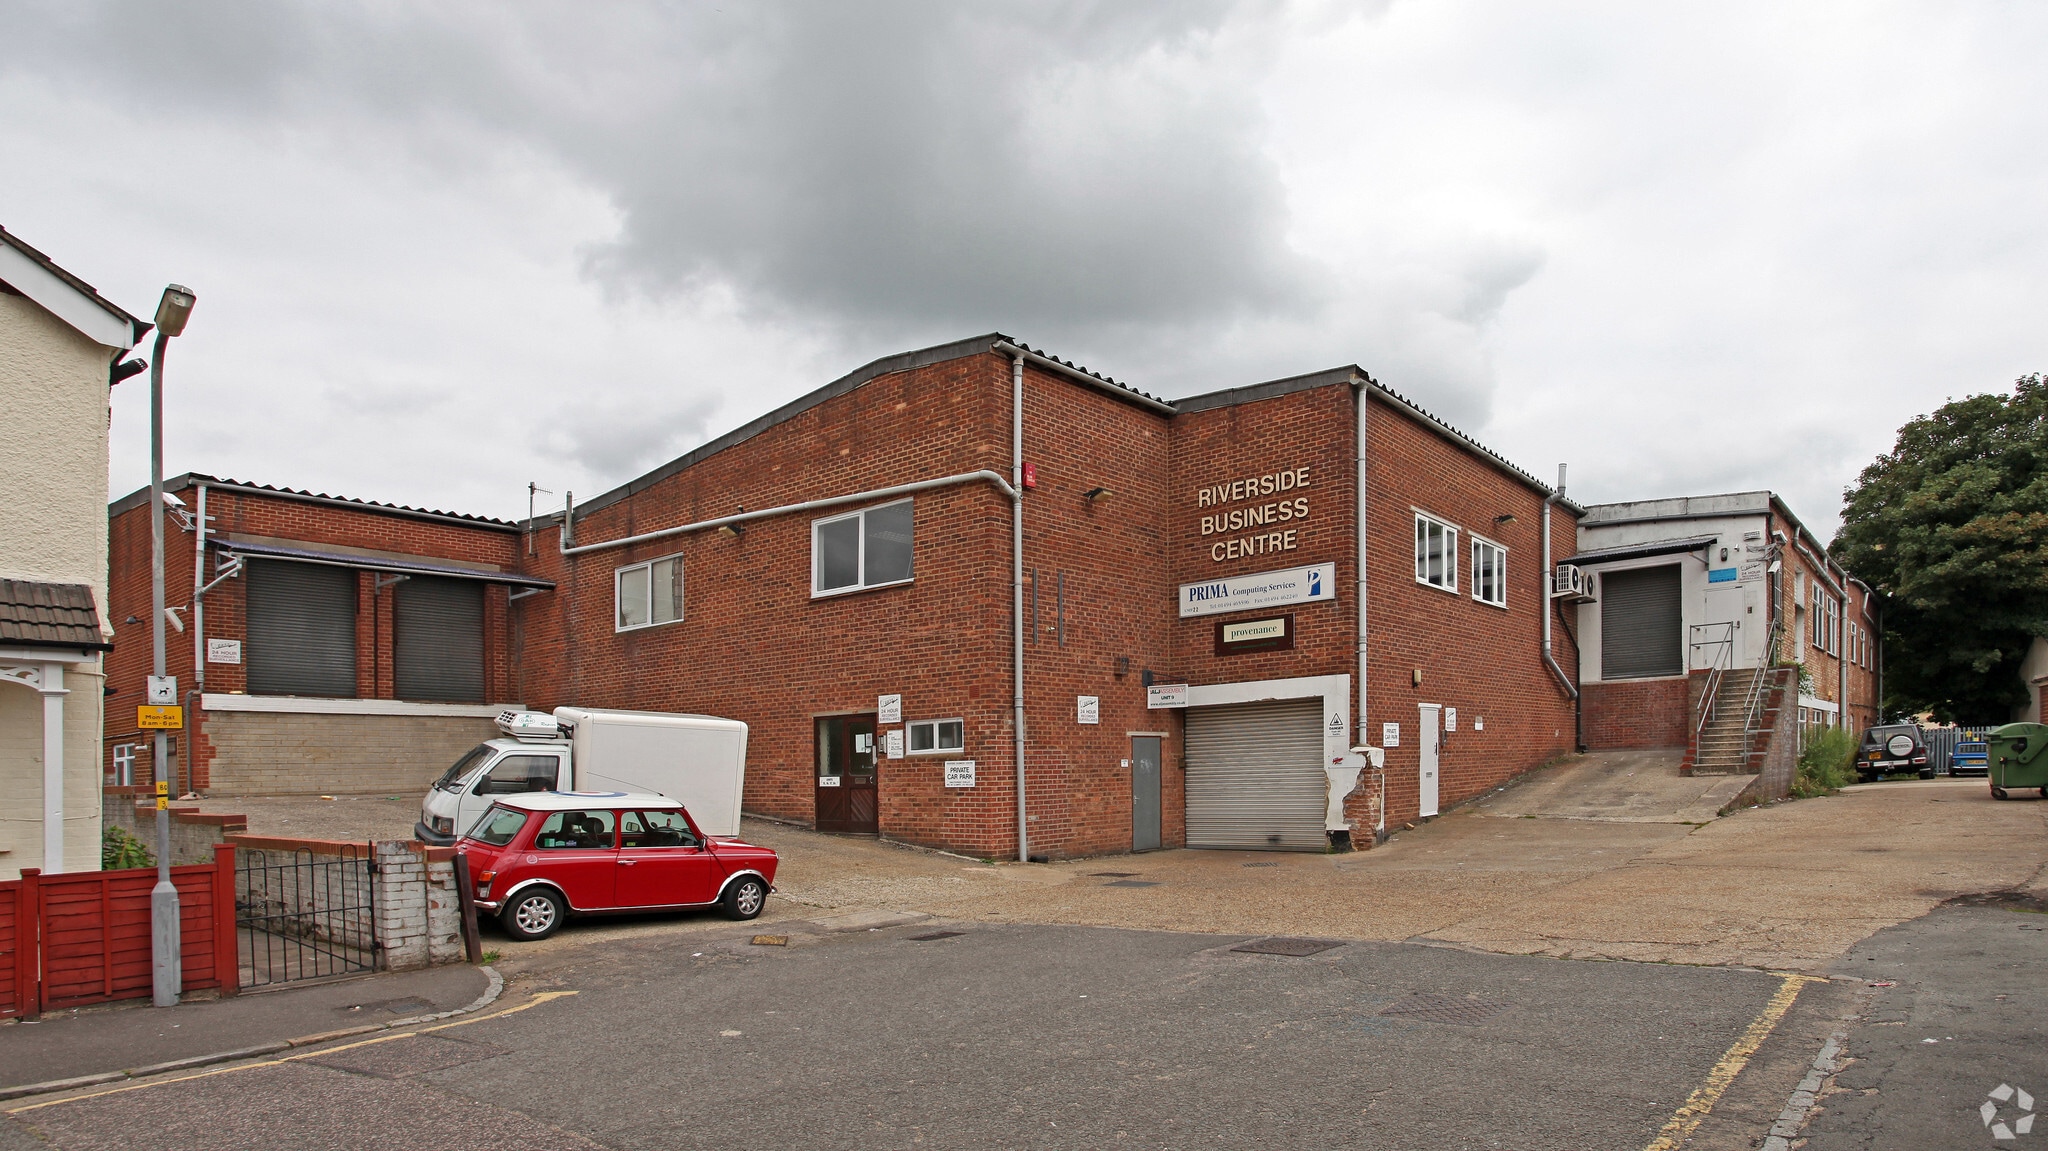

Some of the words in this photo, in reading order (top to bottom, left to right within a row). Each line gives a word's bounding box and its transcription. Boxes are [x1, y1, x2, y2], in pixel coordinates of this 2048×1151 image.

[1198, 466, 1311, 508] RIVERSIDE
[1201, 497, 1309, 536] BUSINESS
[1211, 529, 1298, 562] CENTRE
[1189, 583, 1229, 602] PRIMA
[1232, 585, 1268, 596] Computing
[1268, 581, 1296, 591] Services
[1231, 625, 1278, 640] provenance
